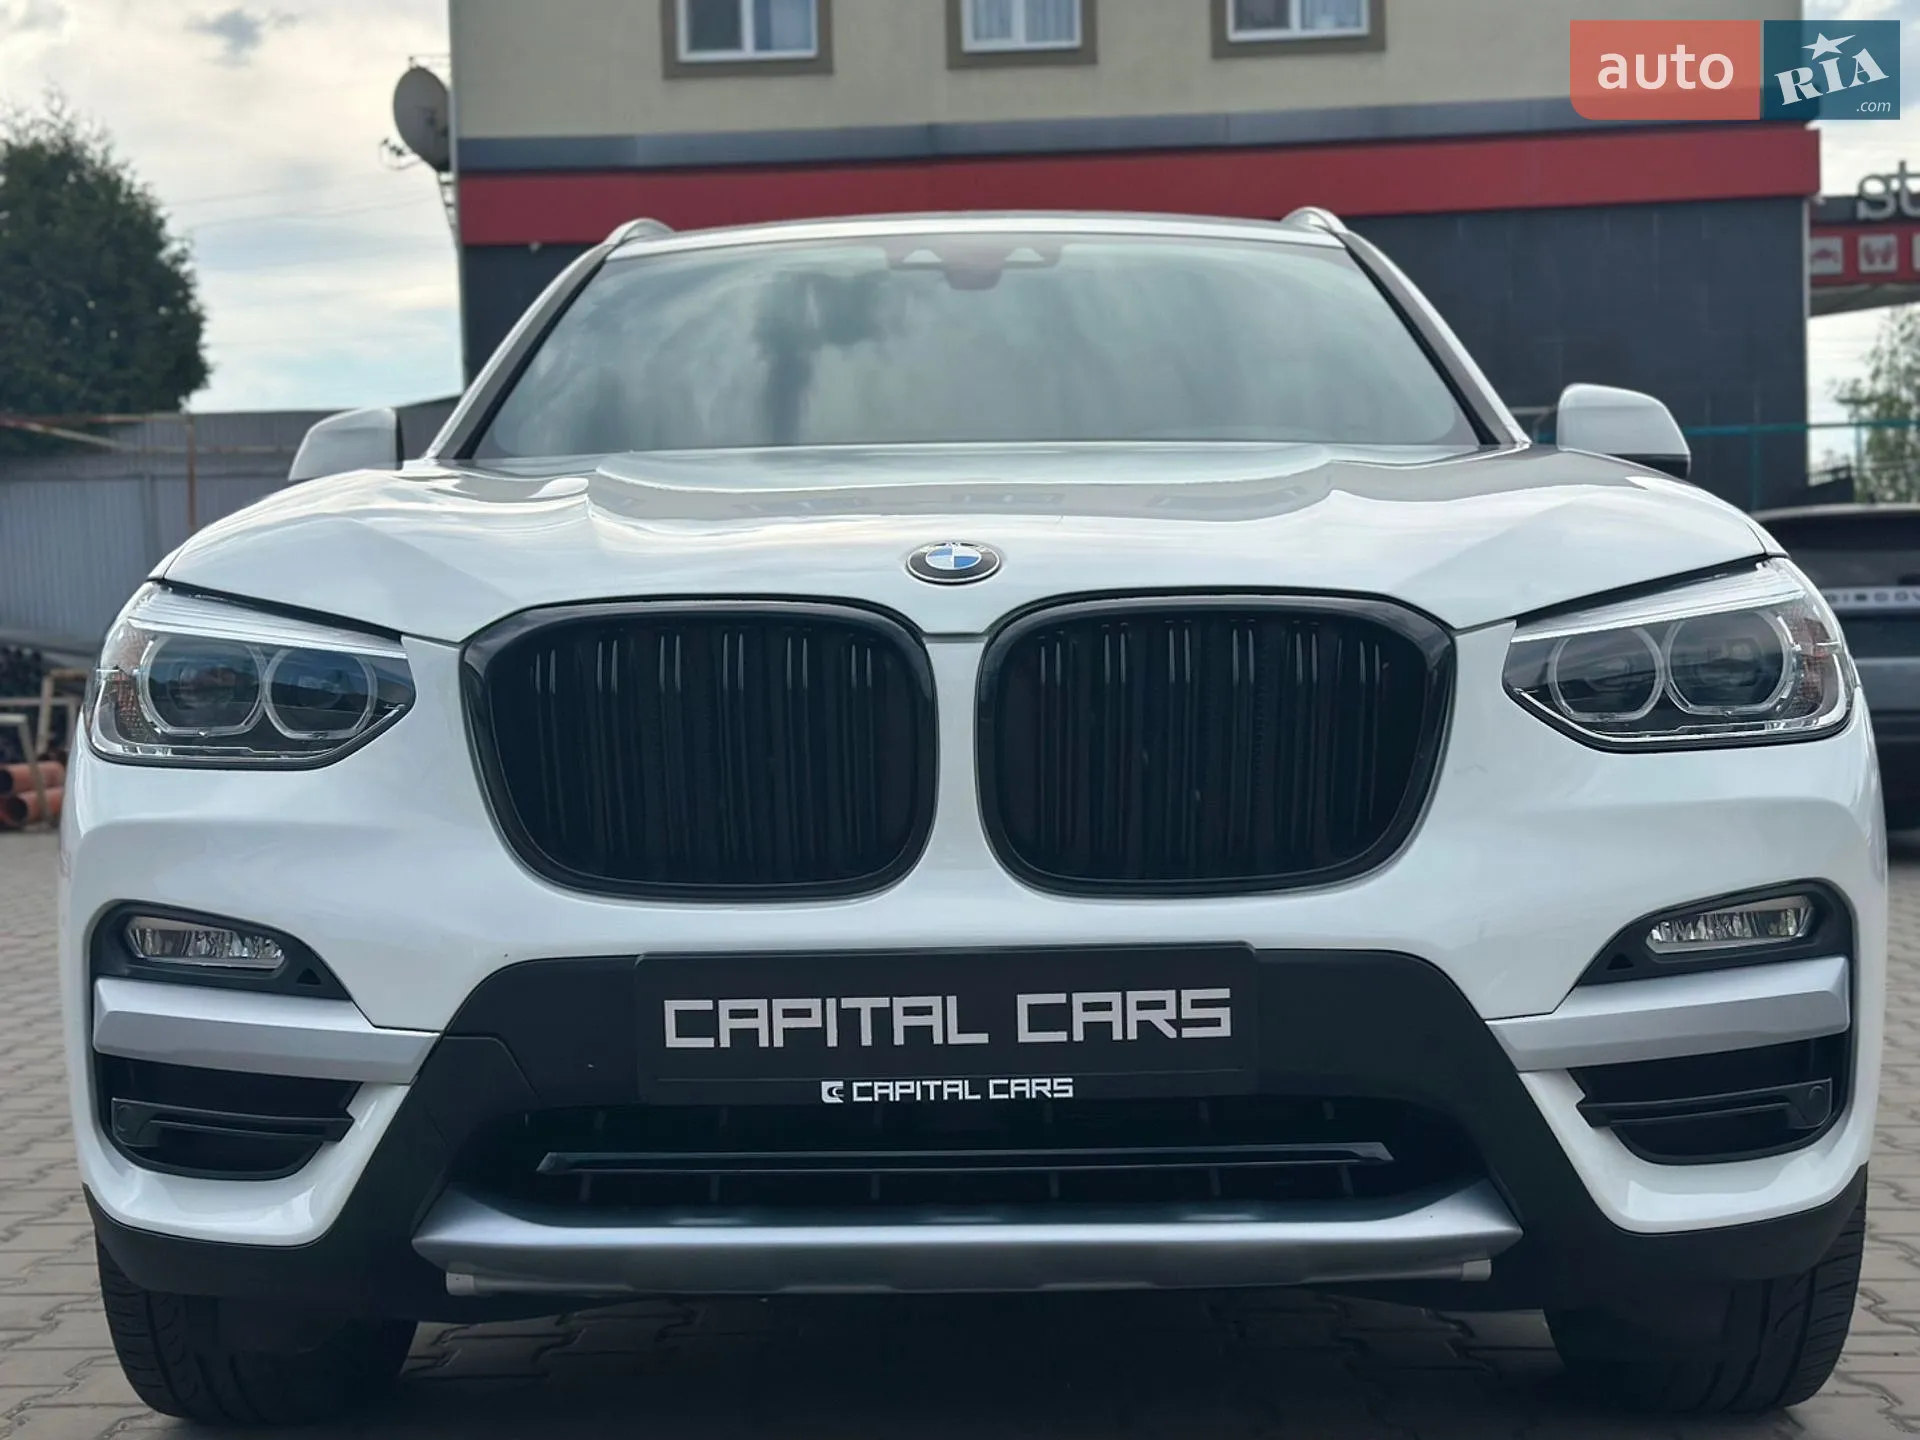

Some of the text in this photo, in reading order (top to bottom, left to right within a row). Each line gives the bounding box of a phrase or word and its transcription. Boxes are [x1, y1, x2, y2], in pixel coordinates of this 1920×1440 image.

[664, 988, 1231, 1047] CAPITAL CARS
[853, 1078, 1073, 1101] CAPITAL CARS
